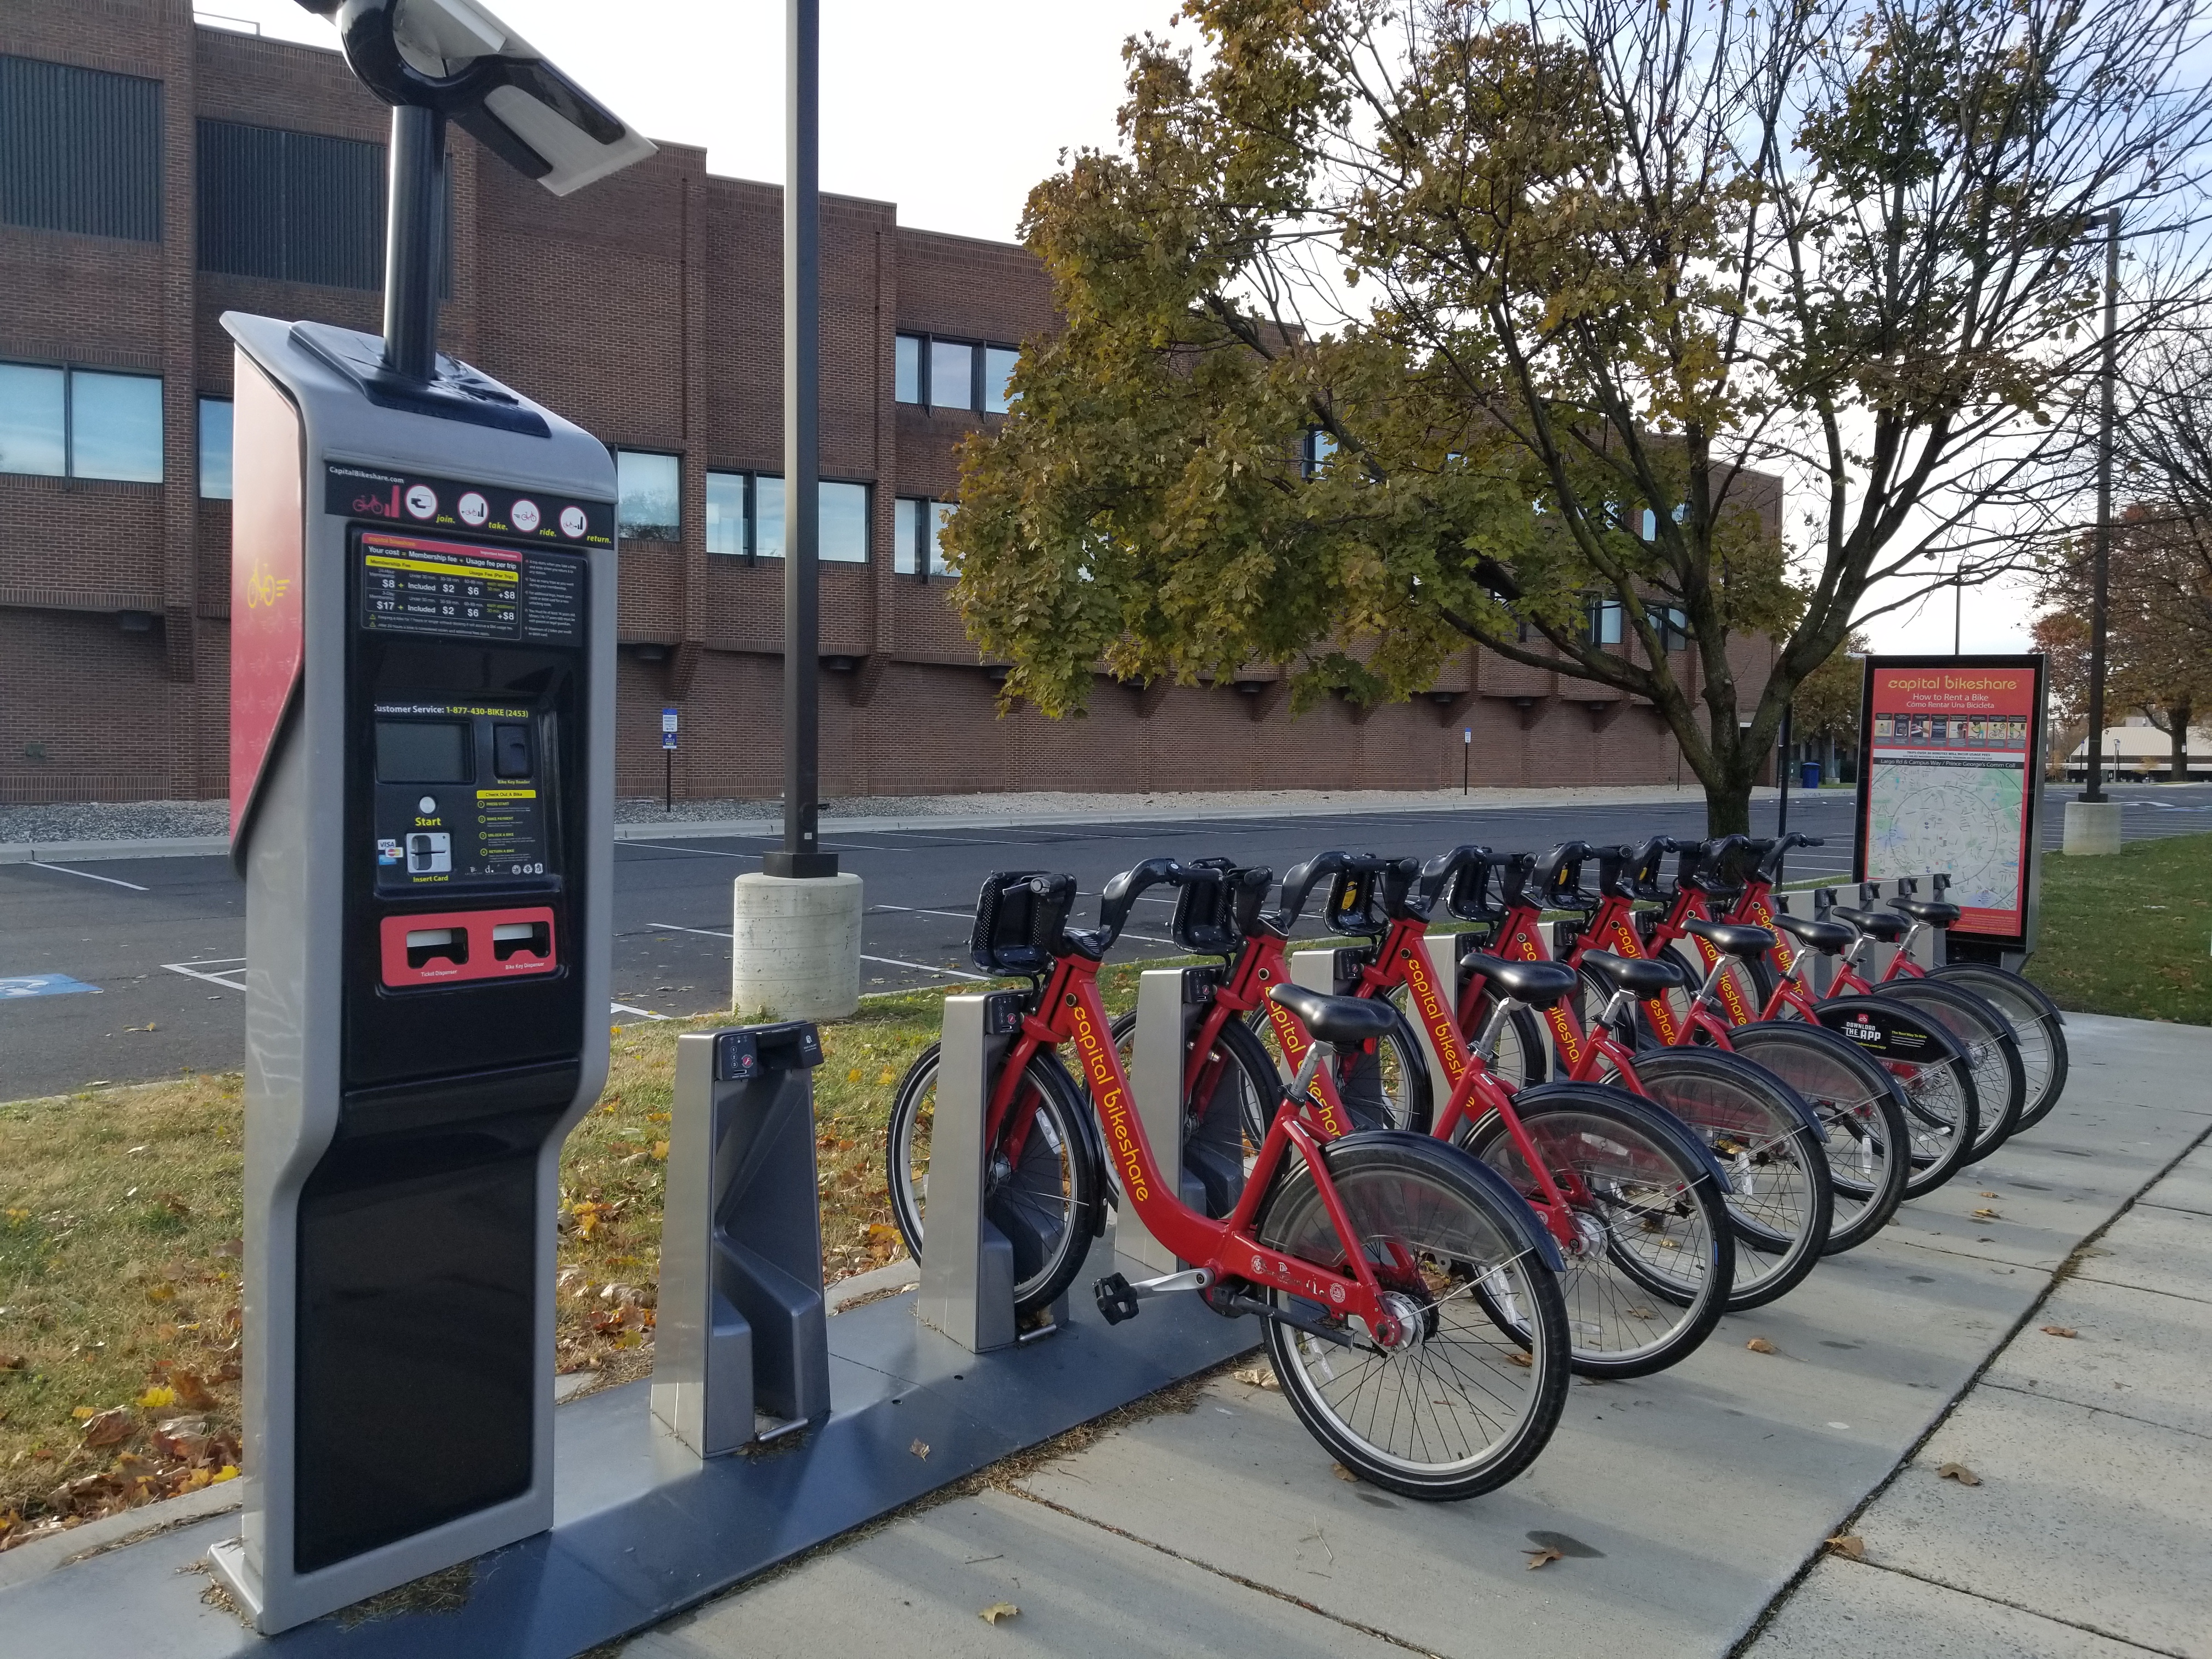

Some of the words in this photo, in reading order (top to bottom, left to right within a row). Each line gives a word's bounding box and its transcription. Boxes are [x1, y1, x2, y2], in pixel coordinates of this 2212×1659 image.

[329, 466, 404, 483] CapitalBikeshare.com
[436, 514, 455, 524] join.
[488, 522, 508, 531] take.
[539, 528, 557, 537] ride.
[586, 535, 612, 544] return.
[409, 551, 447, 562] Membership
[466, 557, 485, 566] Usage
[382, 579, 395, 589] $8
[408, 582, 436, 591] Included
[442, 583, 455, 594] $2
[467, 586, 479, 596] $6
[498, 590, 516, 600] +$8
[376, 601, 394, 611] $17
[407, 605, 436, 613] Included
[442, 606, 455, 615] $2
[467, 608, 479, 617] $6
[497, 612, 515, 621] +$8
[1888, 676, 1940, 692] capital
[1945, 675, 2017, 690] bikeshare
[1972, 693, 1989, 702] Bike
[413, 706, 444, 714] Service:
[445, 706, 504, 716] 1-877-430-BIKE
[506, 709, 528, 718] (2453)
[414, 817, 442, 827] Start
[1408, 960, 1444, 1019] capital
[1846, 1022, 1876, 1031] DOWNLOAD
[1860, 1030, 1881, 1041] APP
[1074, 1006, 1115, 1085] capital
[1104, 1087, 1149, 1202] bikeshare
